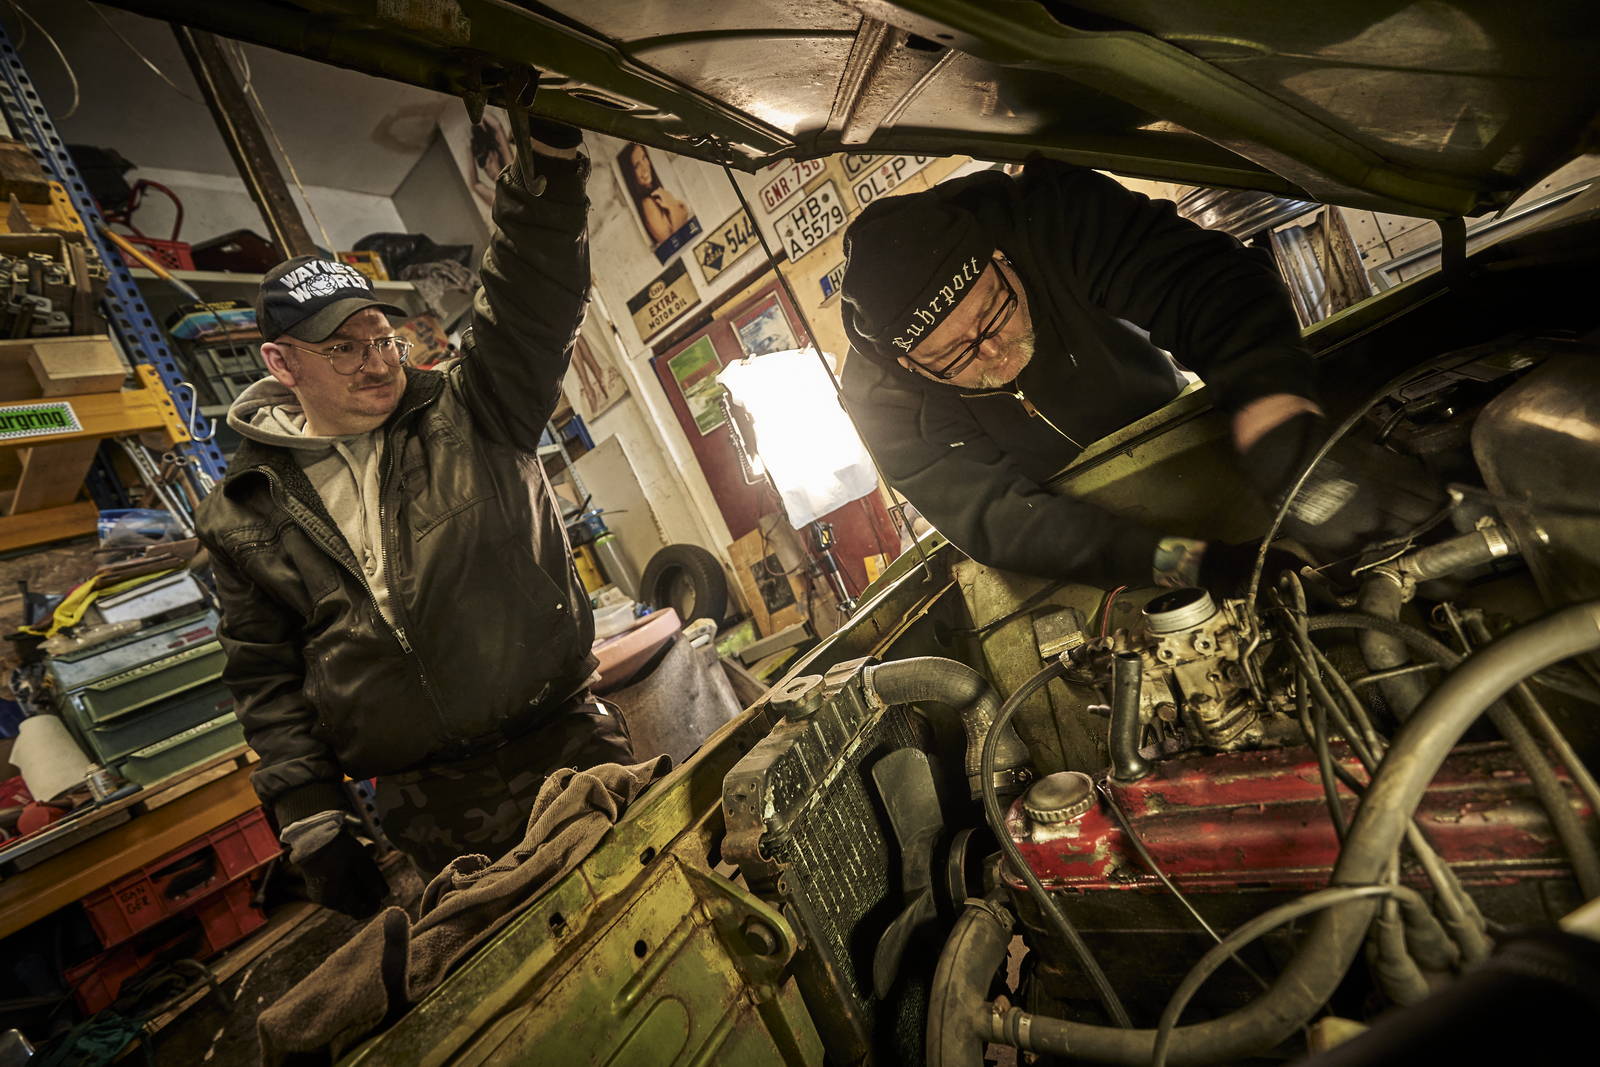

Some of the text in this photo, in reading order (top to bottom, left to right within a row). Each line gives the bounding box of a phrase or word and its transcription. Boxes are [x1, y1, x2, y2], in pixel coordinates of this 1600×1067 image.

[791, 197, 821, 230] HB
[288, 272, 370, 303] WORLD
[648, 290, 679, 318] EXTRA
[648, 298, 688, 330] MOTOR OIL
[892, 256, 980, 353] Ruhrpott
